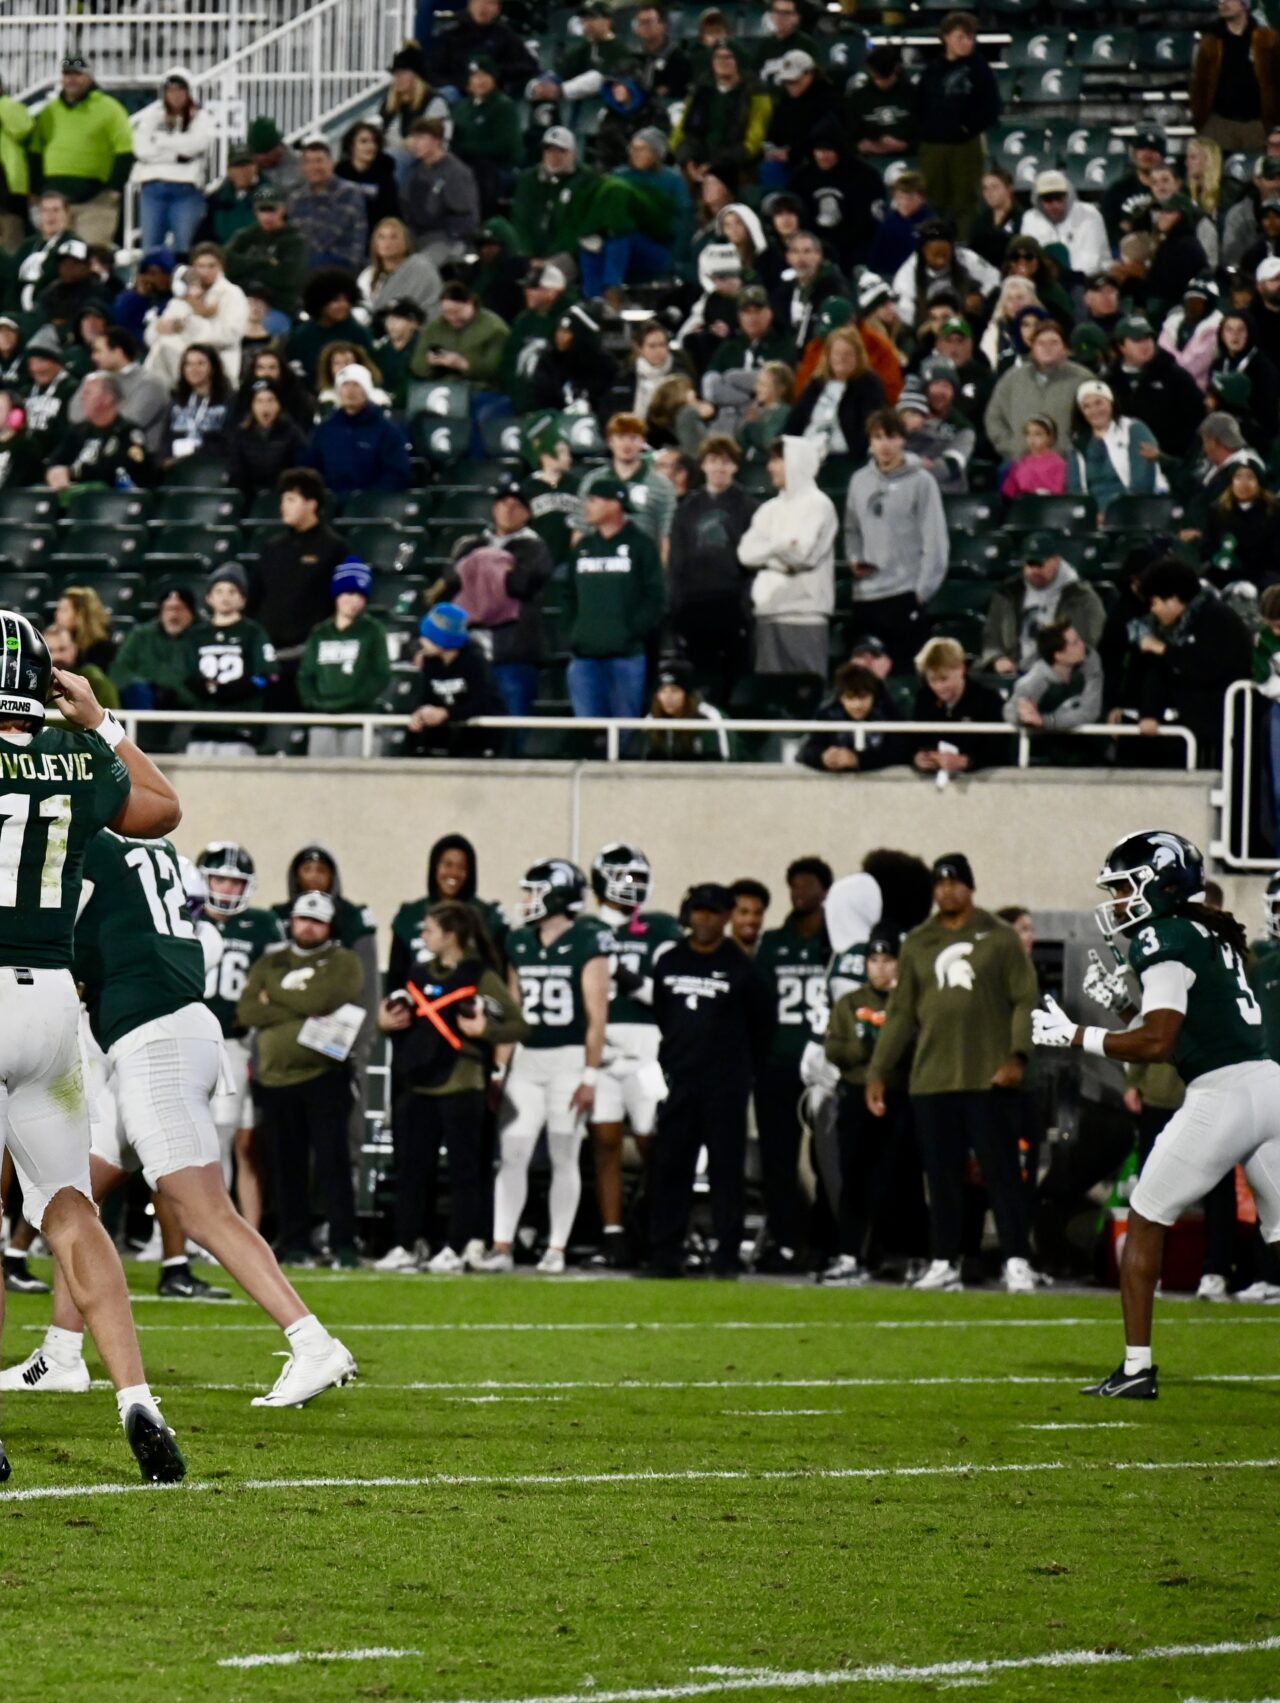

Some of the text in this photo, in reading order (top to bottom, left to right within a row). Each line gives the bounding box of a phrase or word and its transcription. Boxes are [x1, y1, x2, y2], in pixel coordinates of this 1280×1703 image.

[124, 847, 200, 940] 12
[1138, 926, 1160, 956] 3
[519, 977, 574, 1026] 29
[1221, 942, 1262, 1025] 3
[22, 1356, 49, 1386] NIKE
